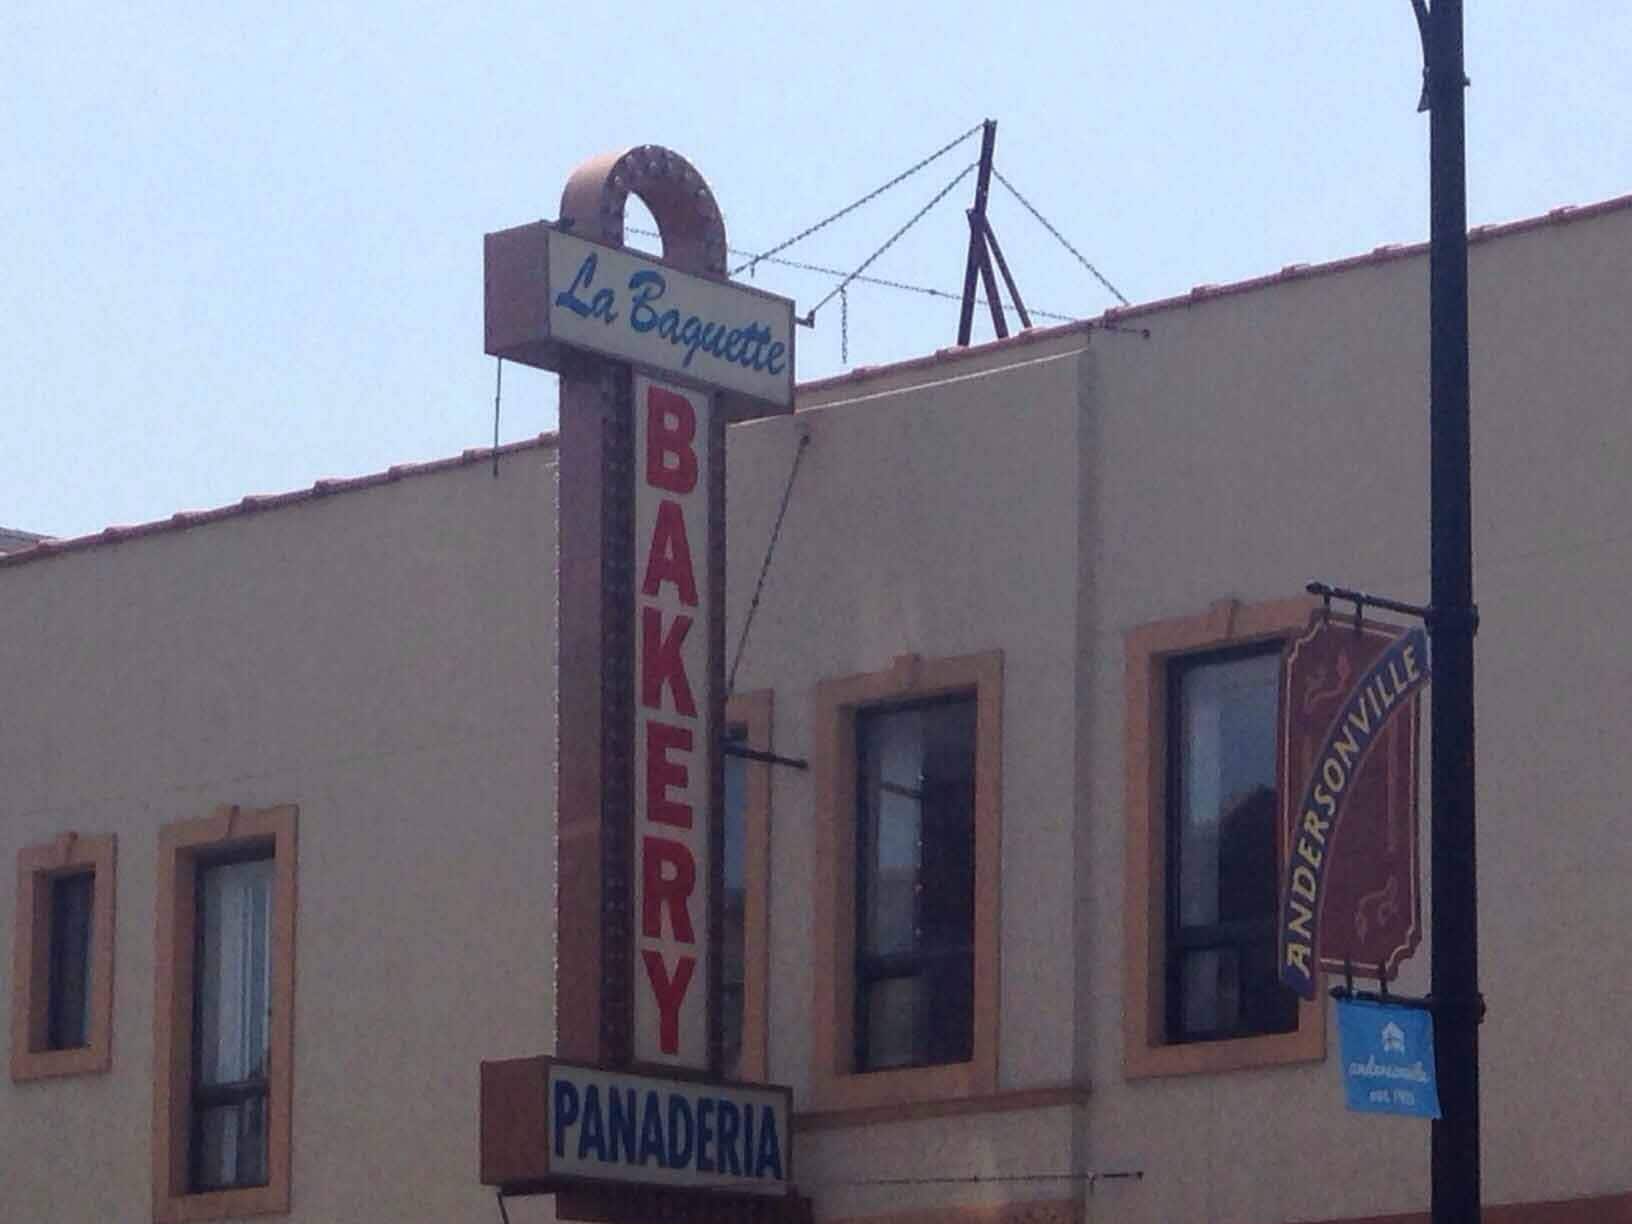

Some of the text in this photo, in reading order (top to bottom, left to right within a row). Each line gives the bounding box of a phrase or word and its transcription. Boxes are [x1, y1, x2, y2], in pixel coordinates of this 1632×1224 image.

[555, 250, 787, 376] La Baguette
[640, 384, 699, 1056] BAKERY
[1286, 644, 1421, 980] ANDERSONVILLE
[553, 1078, 784, 1181] PANADERIA
